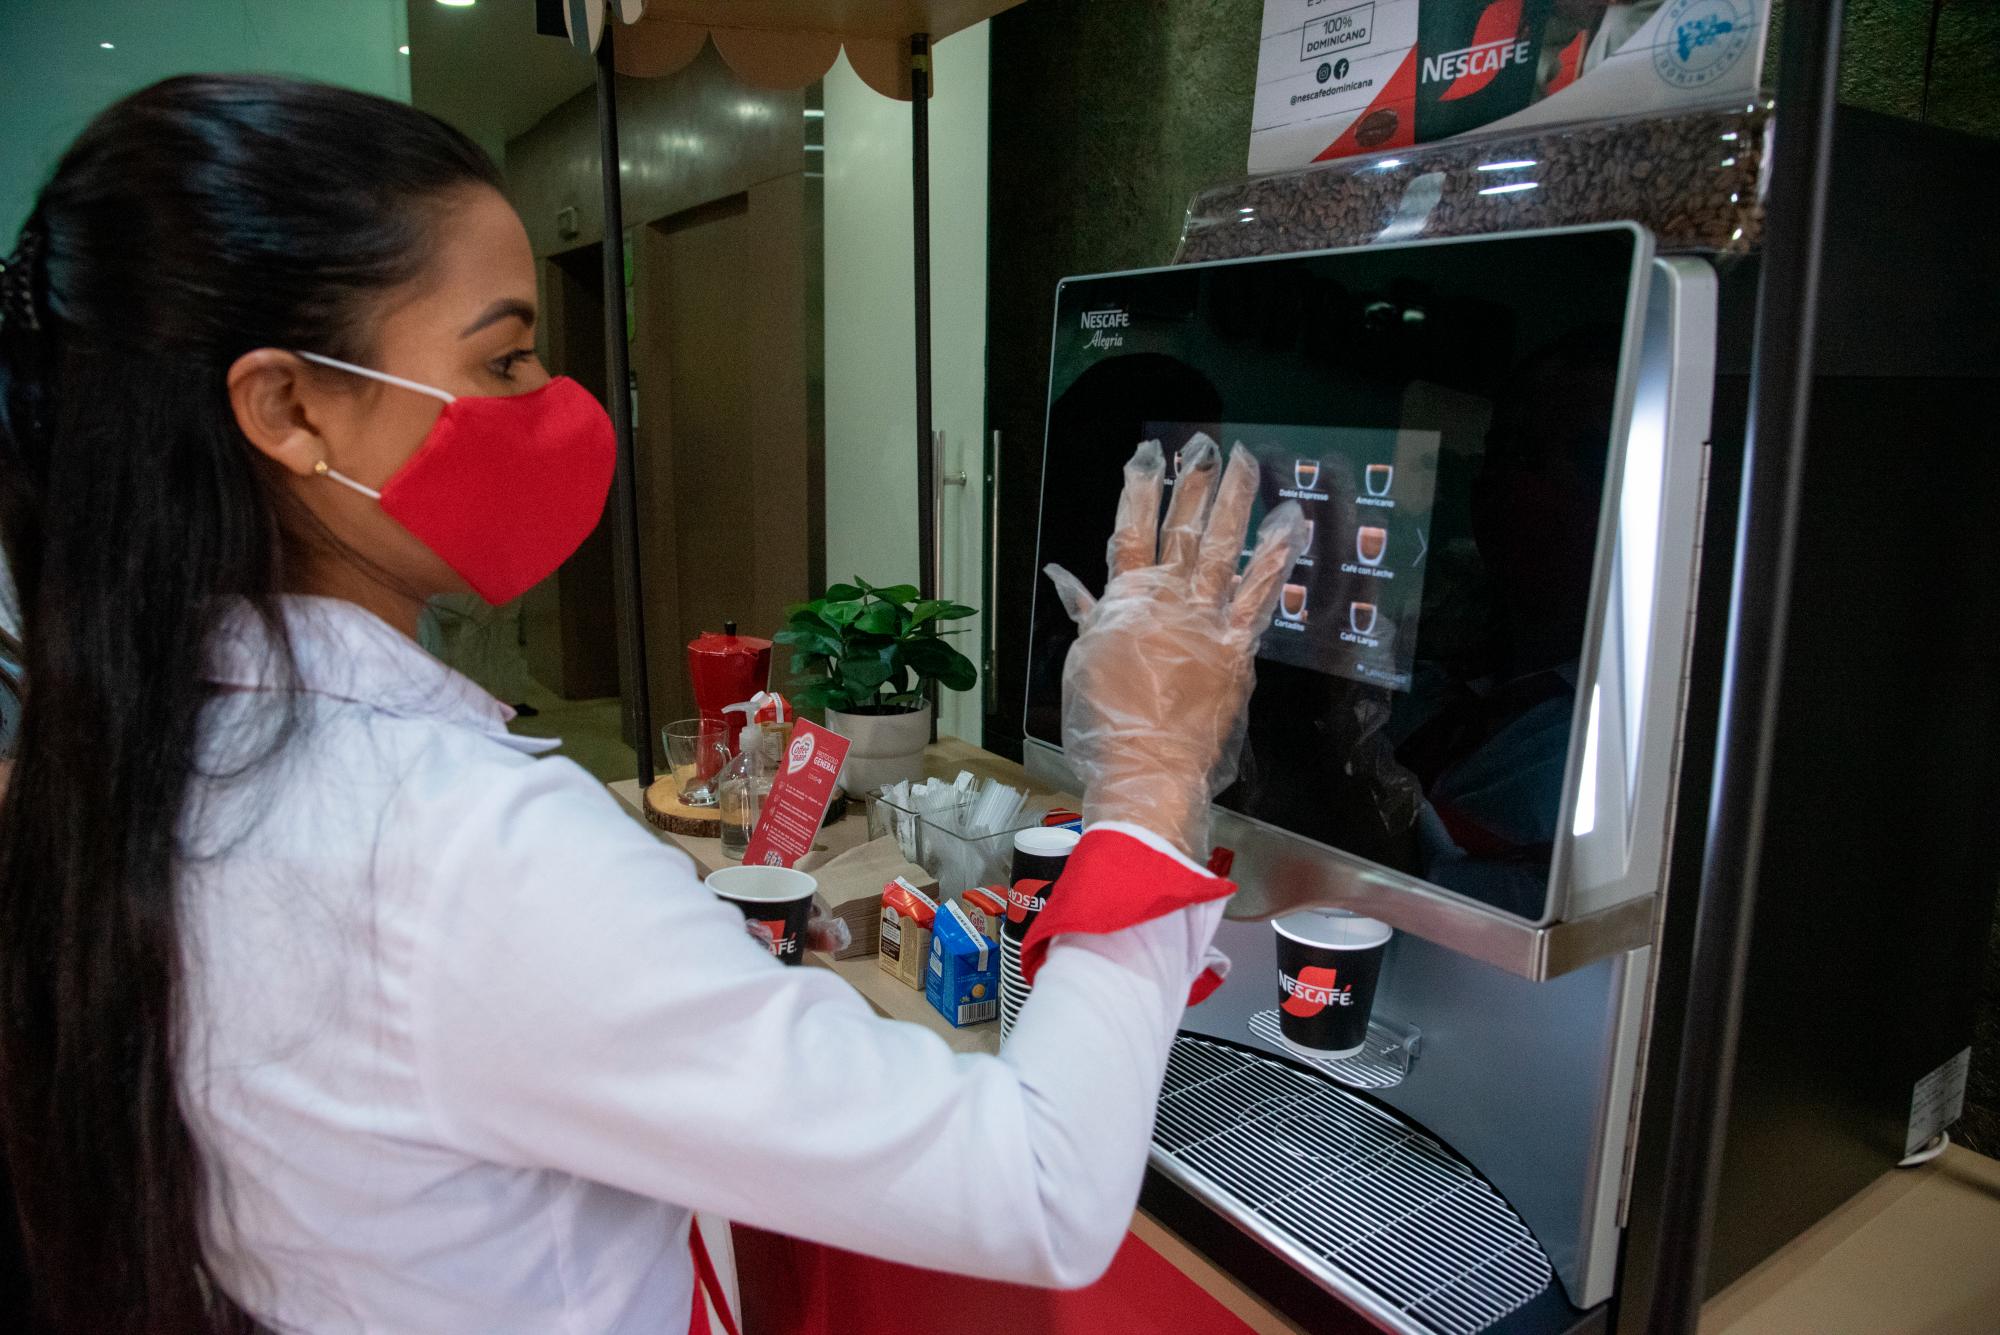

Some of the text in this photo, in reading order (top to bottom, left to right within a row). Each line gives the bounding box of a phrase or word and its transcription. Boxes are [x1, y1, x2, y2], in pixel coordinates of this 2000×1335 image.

[1323, 15, 1353, 35] 100%
[1306, 27, 1366, 53] DOMINICANO
[1290, 79, 1373, 106] @nescafedominicana
[1355, 496, 1395, 508] Americano
[813, 756, 837, 775] GENERAL
